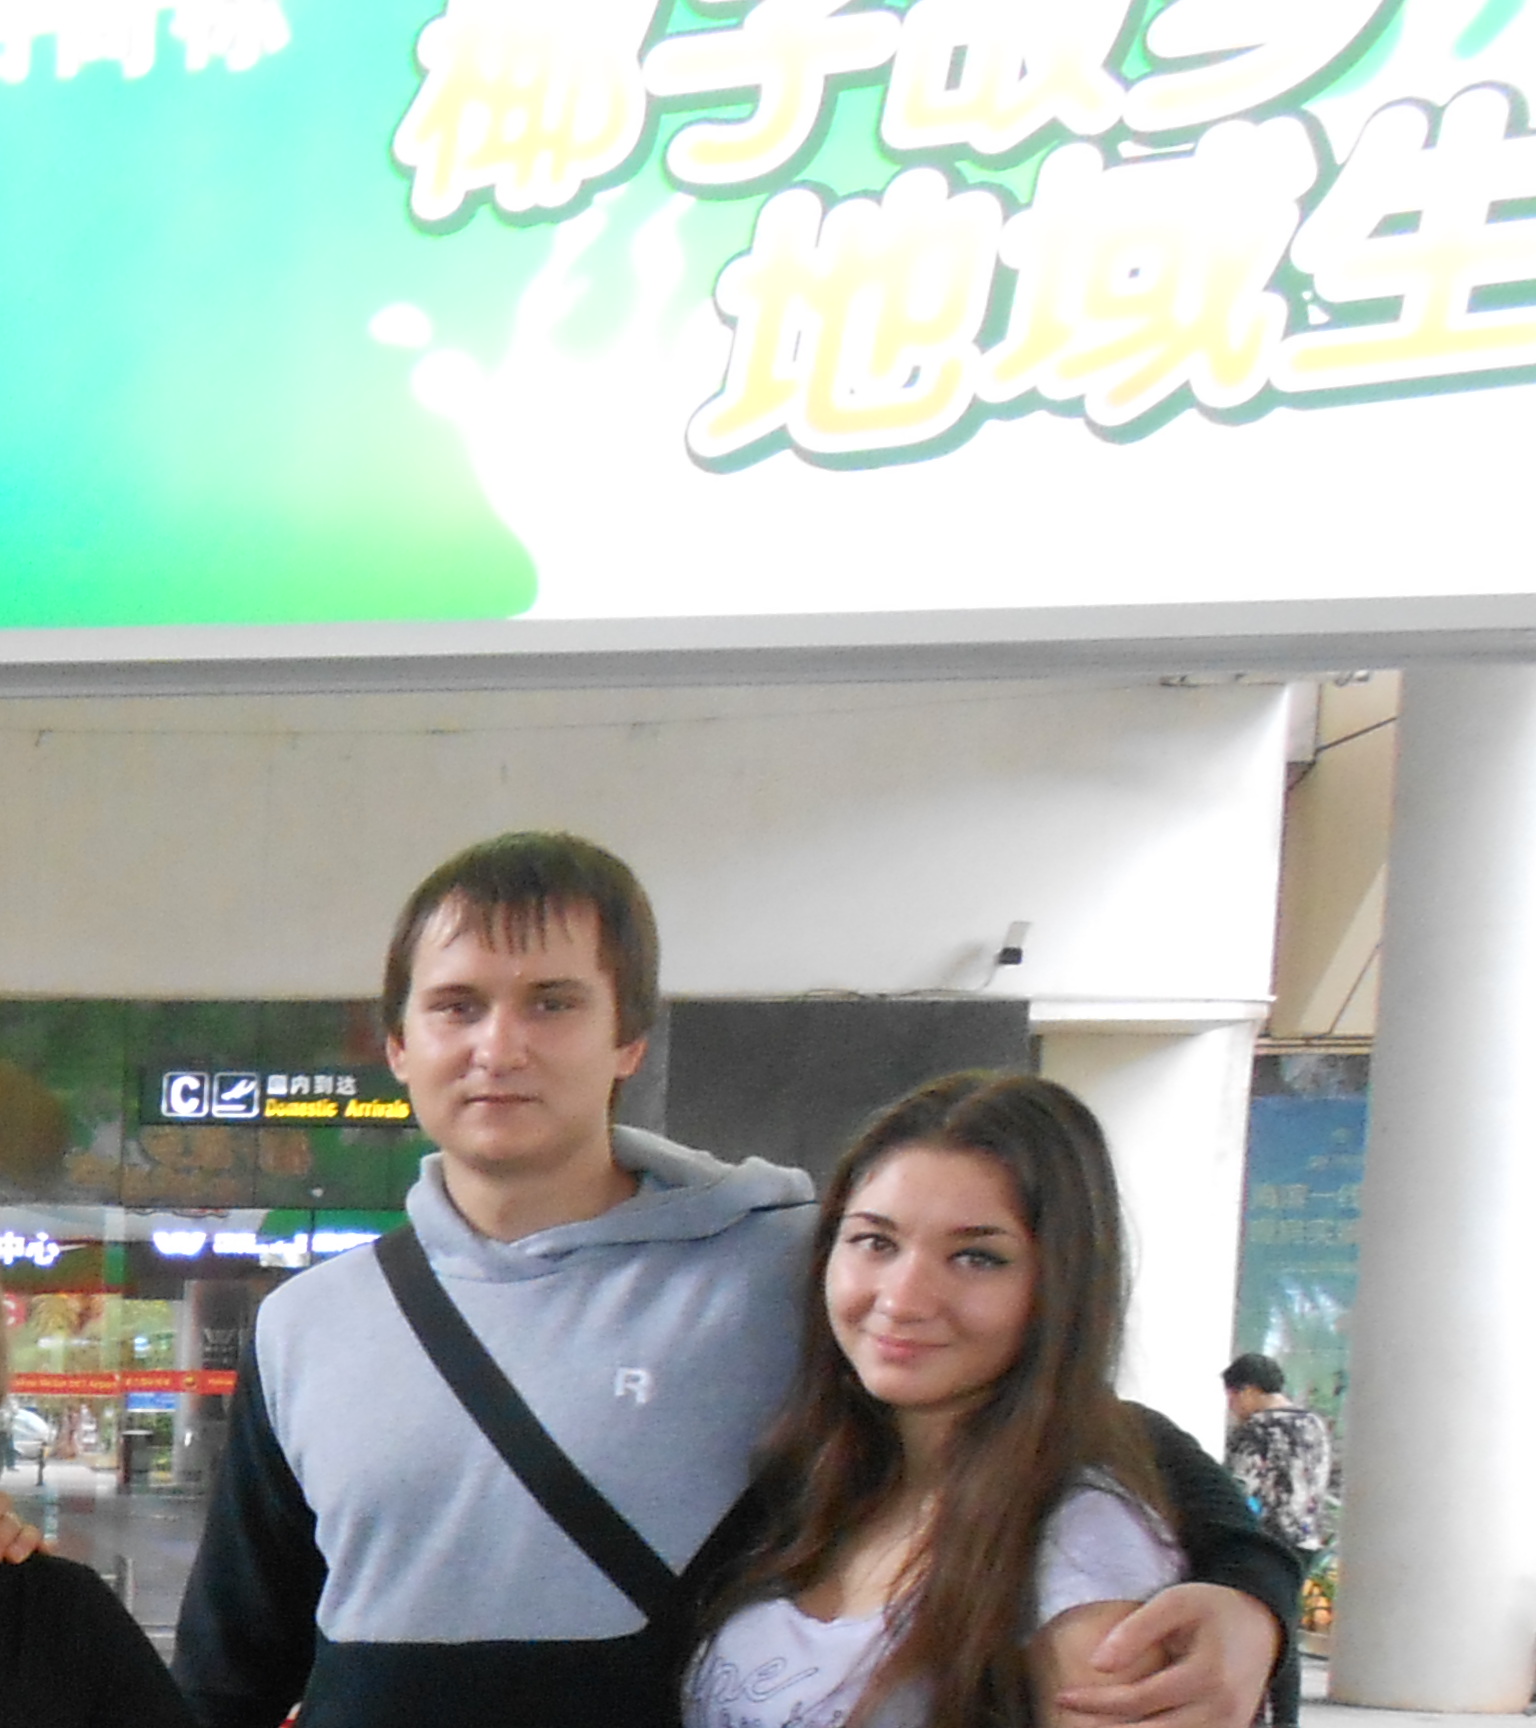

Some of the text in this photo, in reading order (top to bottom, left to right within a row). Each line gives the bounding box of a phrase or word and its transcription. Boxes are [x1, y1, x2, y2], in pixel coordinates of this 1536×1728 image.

[170, 1076, 200, 1114] C
[266, 1074, 358, 1096] 国内到达
[264, 1098, 411, 1119] Domestic Arrivals
[615, 1367, 650, 1404] R
